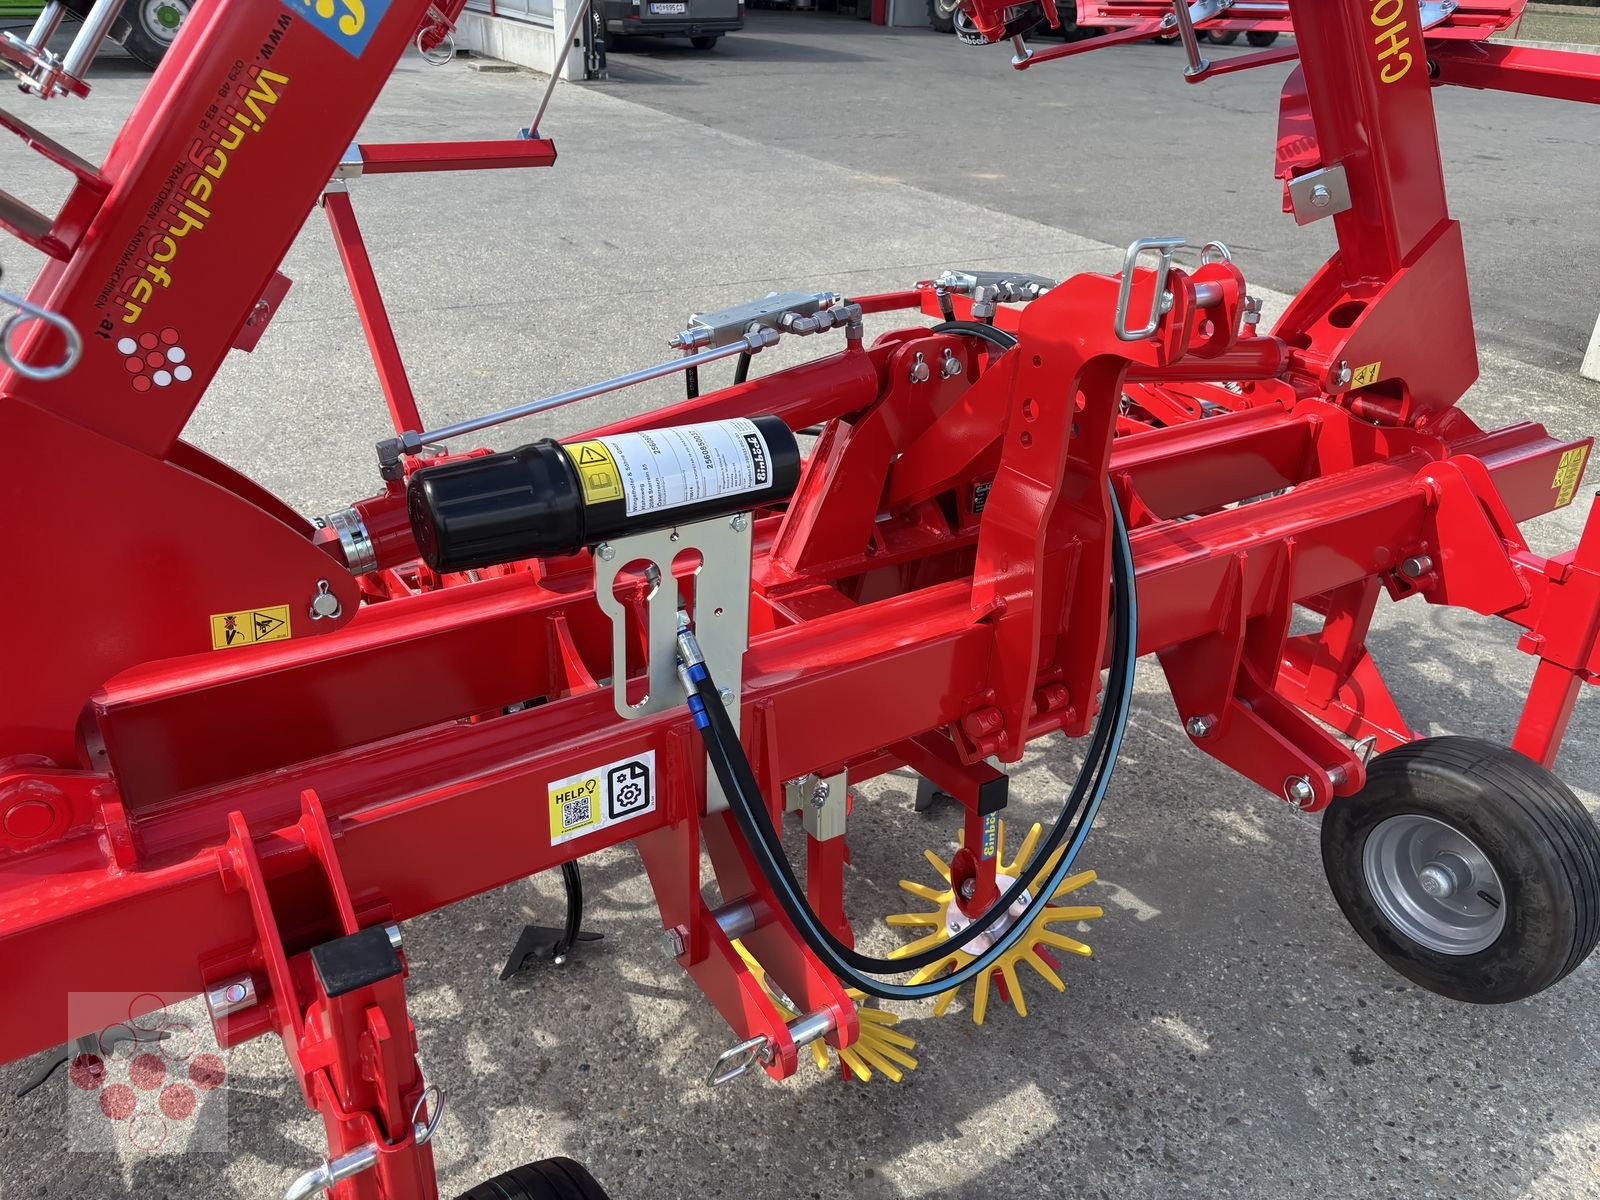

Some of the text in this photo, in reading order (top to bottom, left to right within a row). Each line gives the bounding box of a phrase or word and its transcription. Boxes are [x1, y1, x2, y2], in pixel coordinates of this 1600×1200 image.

[688, 430, 714, 470] 2560850037
[748, 437, 767, 481] Einböck
[556, 788, 584, 804] HELP
